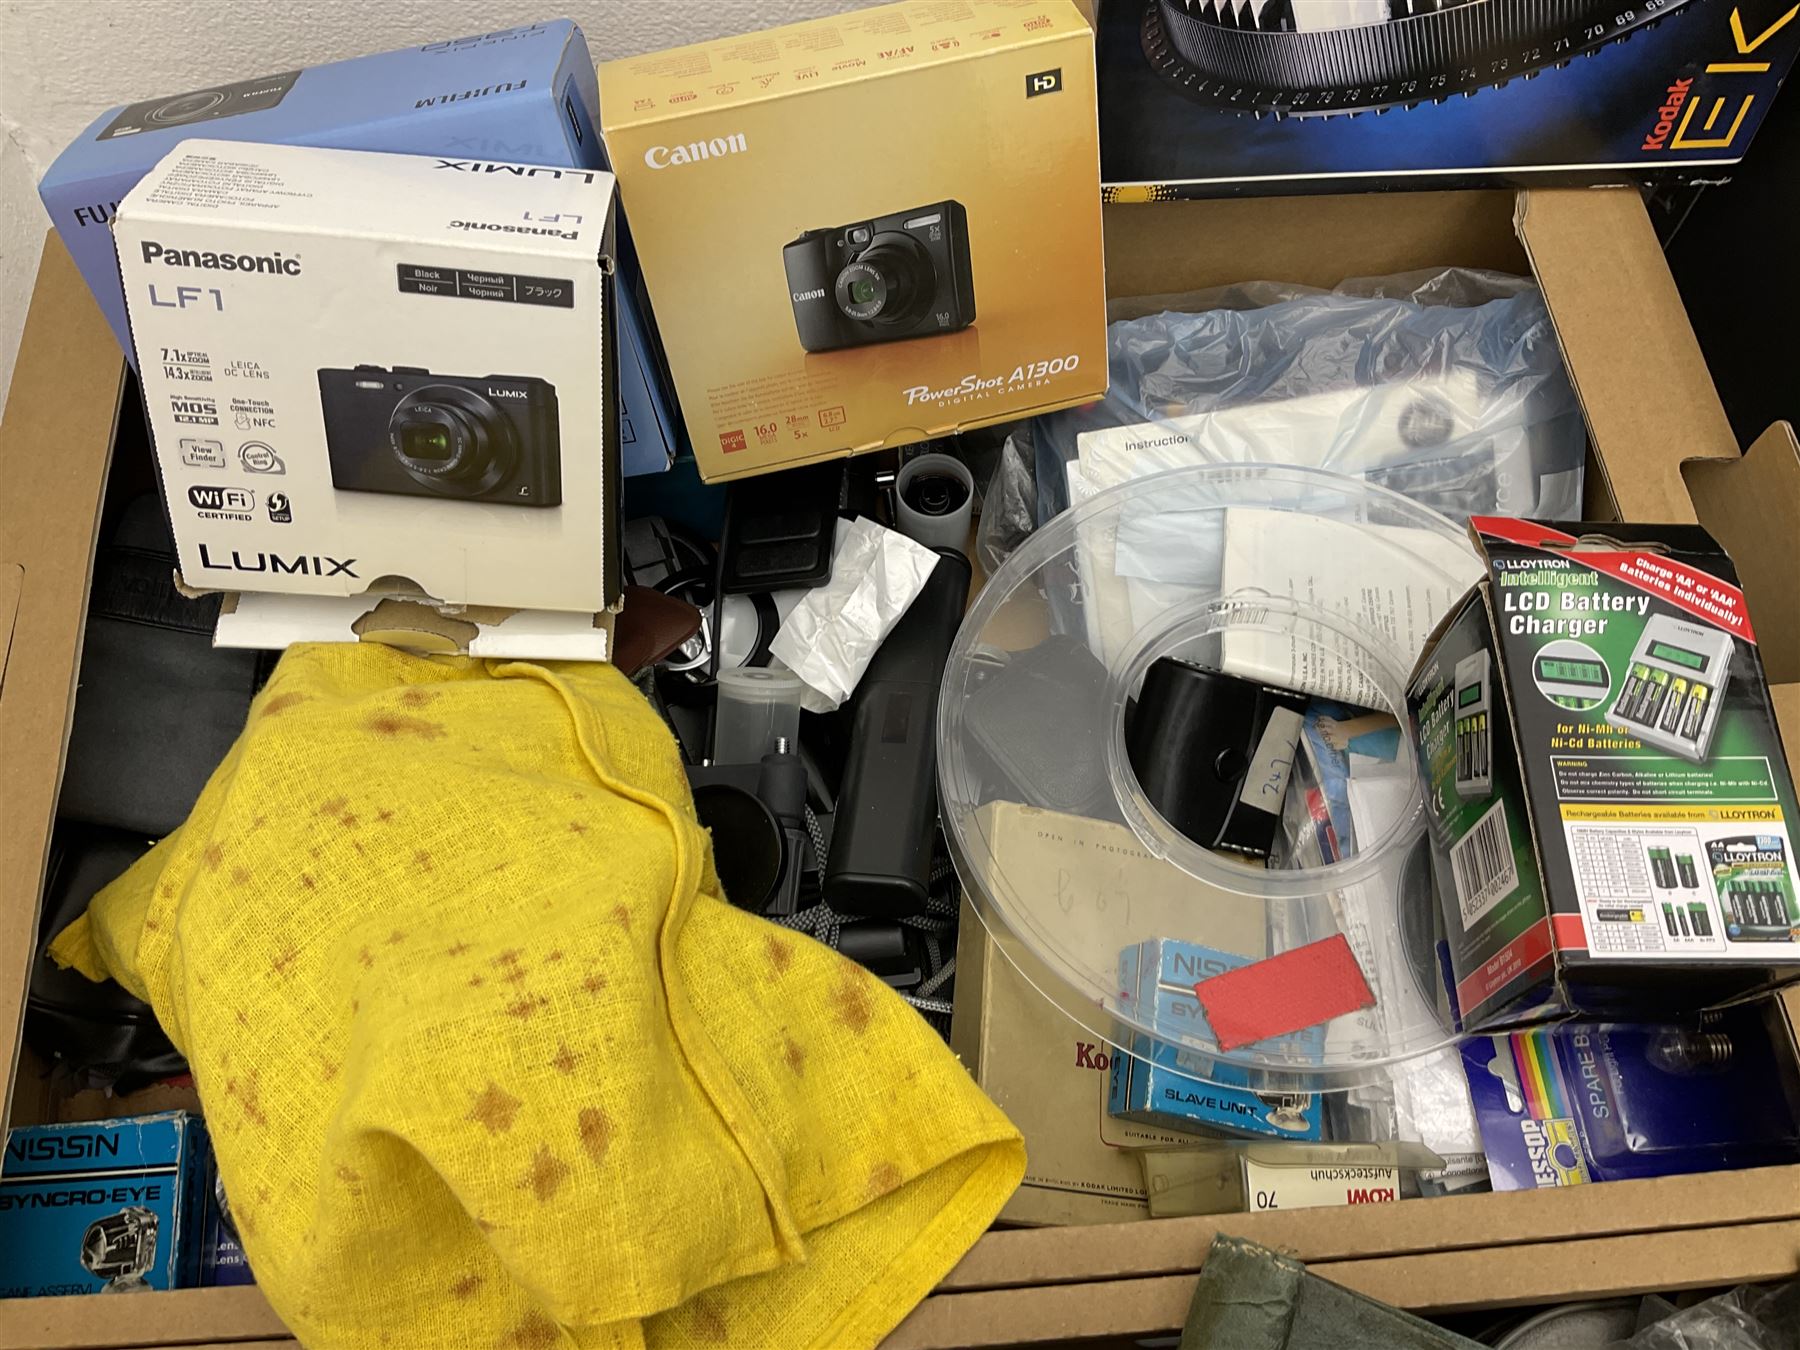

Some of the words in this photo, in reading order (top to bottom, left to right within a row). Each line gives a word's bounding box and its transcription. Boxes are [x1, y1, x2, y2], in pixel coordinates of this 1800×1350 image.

[1230, 88, 1242, 101] 2
[1370, 85, 1388, 98] 77
[1400, 80, 1417, 94] 76
[1429, 74, 1446, 89] 75
[1460, 67, 1476, 81] 74
[1491, 58, 1509, 73] 73
[1522, 48, 1541, 63] 72
[1553, 37, 1570, 52] 71
[1584, 23, 1604, 40] 70
[1615, 10, 1635, 26] 69
[1034, 76, 1056, 92] HD
[415, 79, 527, 109] FUJIFILM
[1641, 78, 1694, 151] Kodak
[644, 132, 748, 170] Canon
[433, 160, 595, 184] LUMIX
[523, 211, 582, 225] LF1
[450, 219, 579, 240] Panasonic
[141, 240, 302, 276] Panasonic
[414, 269, 441, 279] Black
[467, 273, 505, 285] Черный
[418, 283, 438, 293] Noir
[468, 287, 505, 299] Чорний
[524, 285, 562, 299] ブラック
[792, 287, 826, 303] Canon
[149, 284, 224, 311] LF1
[187, 356, 210, 364] ZOOM
[230, 360, 260, 370] LEICA
[164, 366, 191, 381] 14.3x
[191, 374, 213, 382] ZOOM
[224, 368, 238, 378] DC
[243, 369, 270, 380] LENS
[902, 374, 1004, 406] PowerShot
[1008, 354, 1079, 384] A1300
[488, 386, 528, 400] LUMIX
[938, 391, 990, 408] DIGITAL
[998, 378, 1050, 395] CAMERA
[171, 401, 217, 415] MOS
[230, 404, 275, 415] CONNECTION
[232, 397, 270, 408] One-Touch
[254, 417, 276, 428] NFC
[753, 422, 777, 437] 16.0
[190, 452, 216, 462] Finder
[191, 445, 212, 454] View
[198, 511, 253, 522] CERTIFIED
[198, 543, 361, 579] LUMIX
[1506, 559, 1571, 569] LLOYTRON
[1500, 570, 1600, 589] Intelligent
[1619, 562, 1672, 592] Batteries
[1635, 557, 1674, 580] Charge
[1696, 583, 1709, 595] or
[1504, 592, 1551, 612] LCD
[1559, 592, 1651, 616] Battery
[1509, 614, 1609, 639] Charger
[1431, 689, 1454, 729] Battery
[1557, 723, 1574, 735] for
[1578, 723, 1613, 735] Ni-Mh
[1617, 726, 1630, 735] or
[1426, 721, 1450, 761] Charger
[1551, 737, 1584, 749] Ni-Cd
[1587, 738, 1642, 749] Batteries
[1566, 810, 1617, 819] Rechargeable
[1618, 810, 1652, 818] Batteries
[1653, 810, 1686, 818] available
[1688, 810, 1705, 818] from
[1720, 809, 1776, 819] LLOYTRON
[1037, 831, 1063, 842] OPEN
[1074, 839, 1085, 847] IN
[1723, 851, 1782, 863] LLOYTRON
[1578, 1052, 1610, 1119] SPARE
[1164, 1088, 1217, 1109] SLAVE
[1219, 1098, 1258, 1118] UNIT
[1125, 1131, 1157, 1141] SUITABLE
[1161, 1136, 1174, 1144] FOR
[6, 1132, 119, 1162] NISSIN
[1310, 1167, 1393, 1182] Aufsteckschuh
[1081, 1182, 1106, 1190] KODAK
[1256, 1191, 1279, 1209] 70
